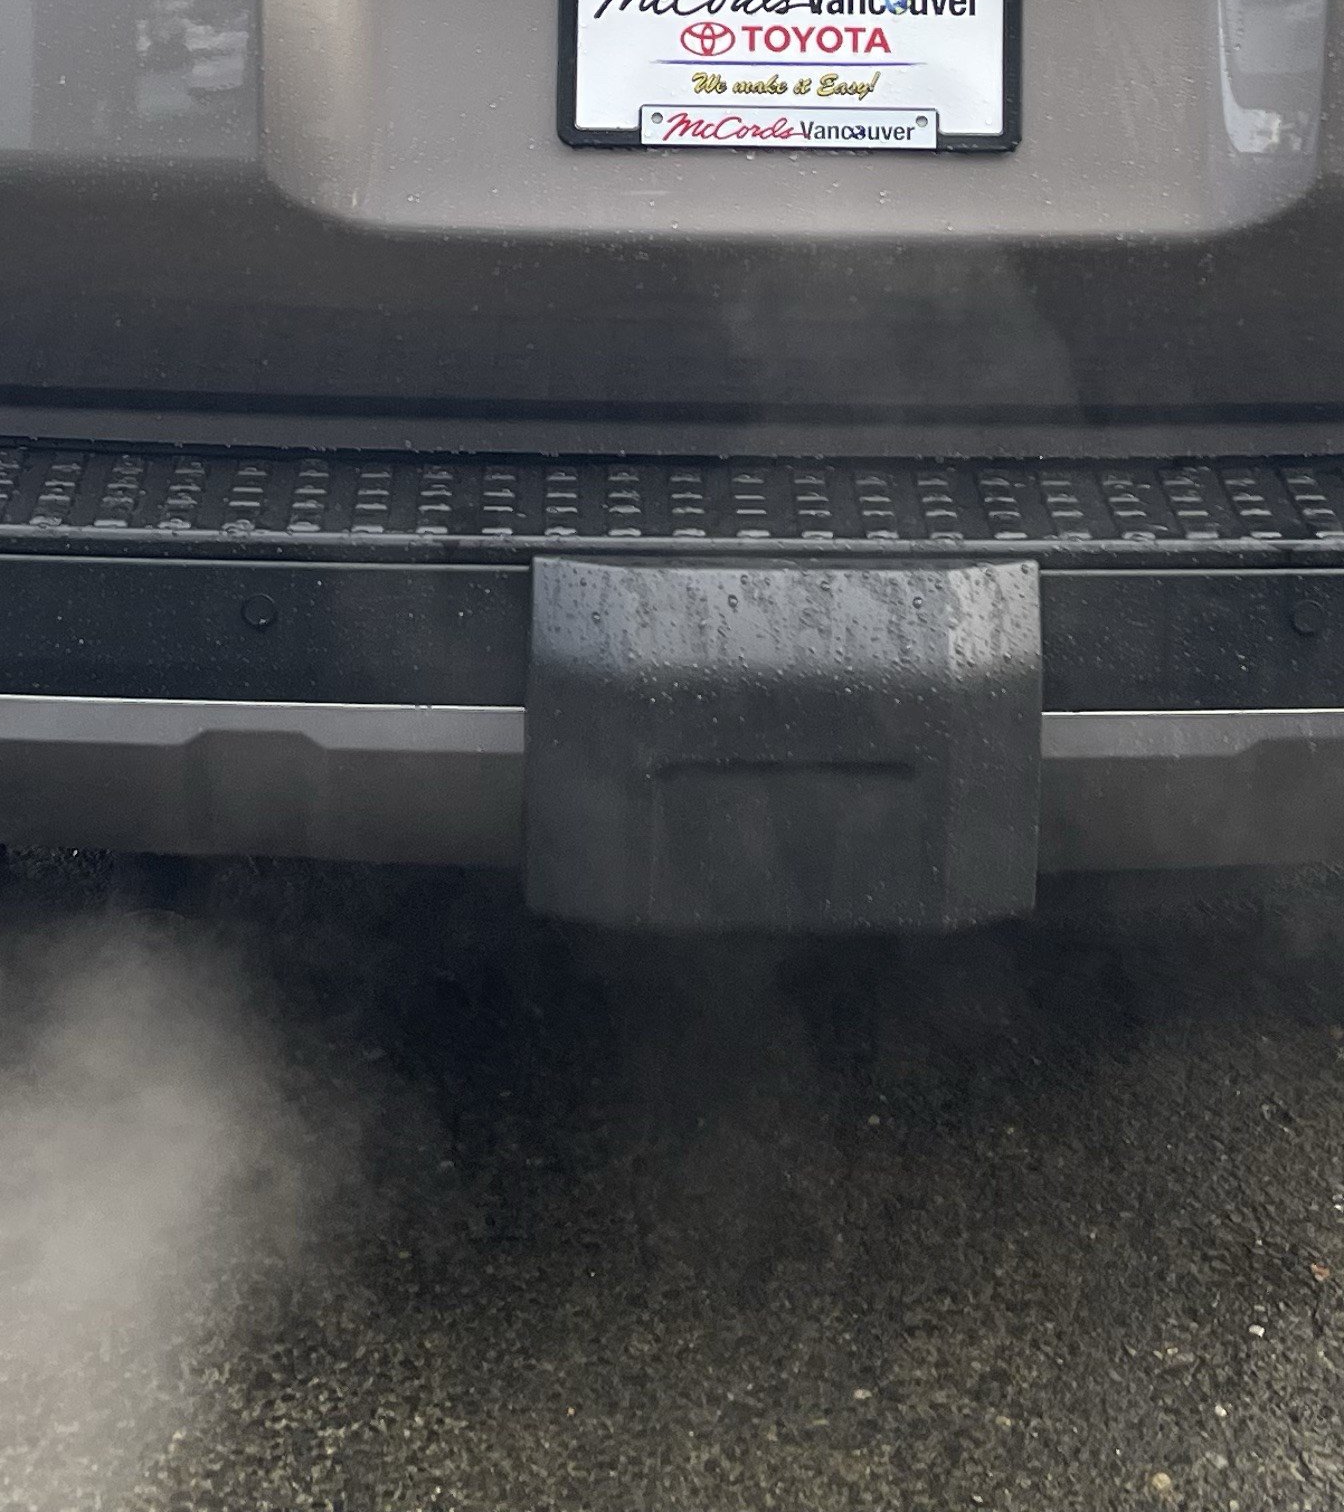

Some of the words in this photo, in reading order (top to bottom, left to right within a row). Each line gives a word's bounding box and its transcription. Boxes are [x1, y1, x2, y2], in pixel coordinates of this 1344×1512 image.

[741, 25, 892, 54] TOYOTA
[691, 71, 728, 95] We
[732, 74, 788, 96] make
[793, 76, 812, 95] it
[816, 71, 881, 101] Easy!
